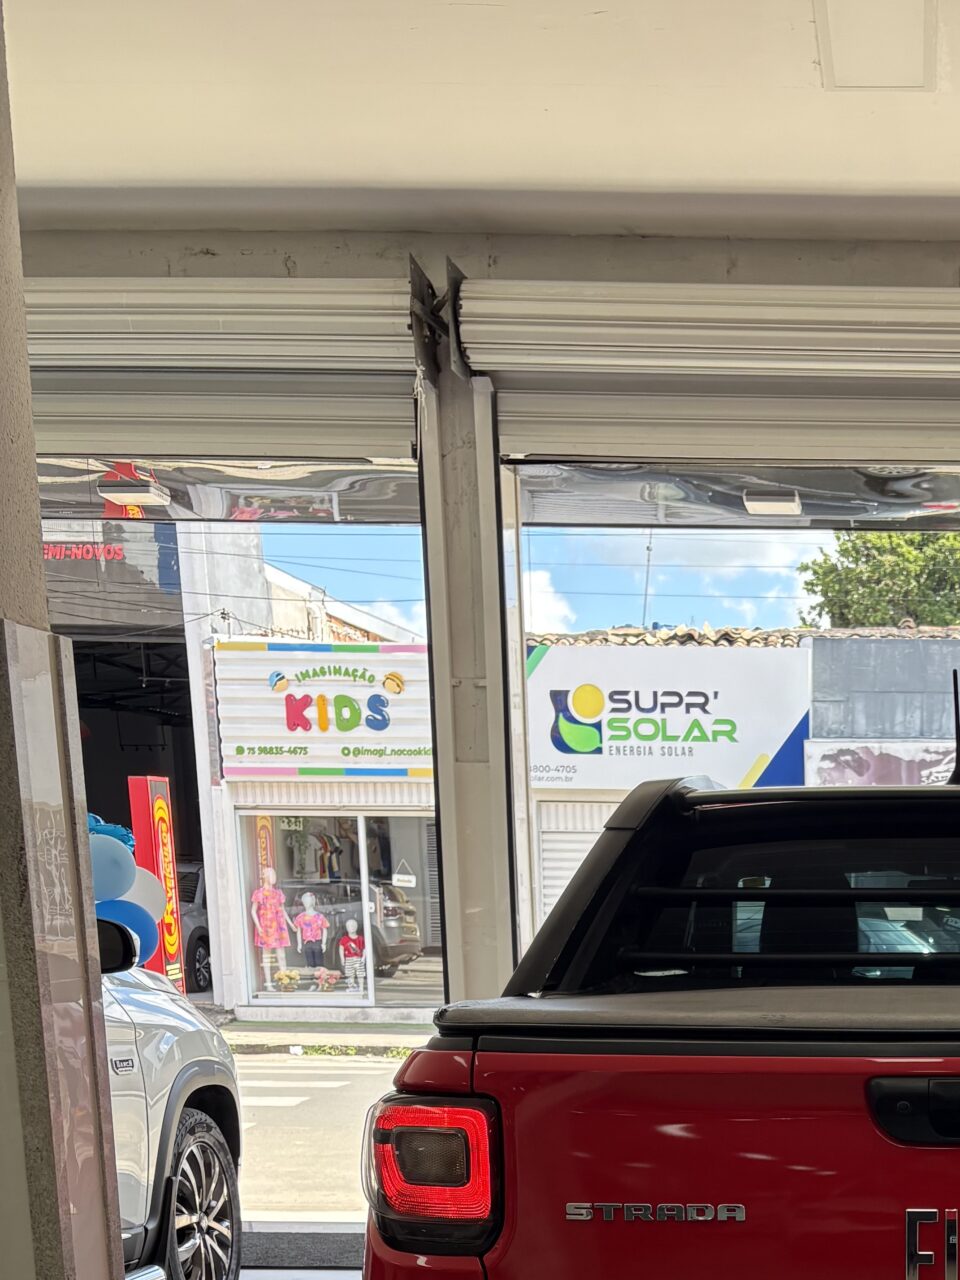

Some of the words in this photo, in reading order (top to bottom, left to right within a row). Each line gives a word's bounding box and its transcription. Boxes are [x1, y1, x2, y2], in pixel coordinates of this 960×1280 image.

[295, 665, 376, 684] IMAGINAÇÃO
[285, 693, 390, 732] KIDS
[606, 718, 738, 743] SOLAR
[608, 745, 653, 756] ENERGIA
[660, 746, 694, 757] SOLAR
[530, 764, 577, 774] 800-4705
[565, 1203, 746, 1221] STRADA
